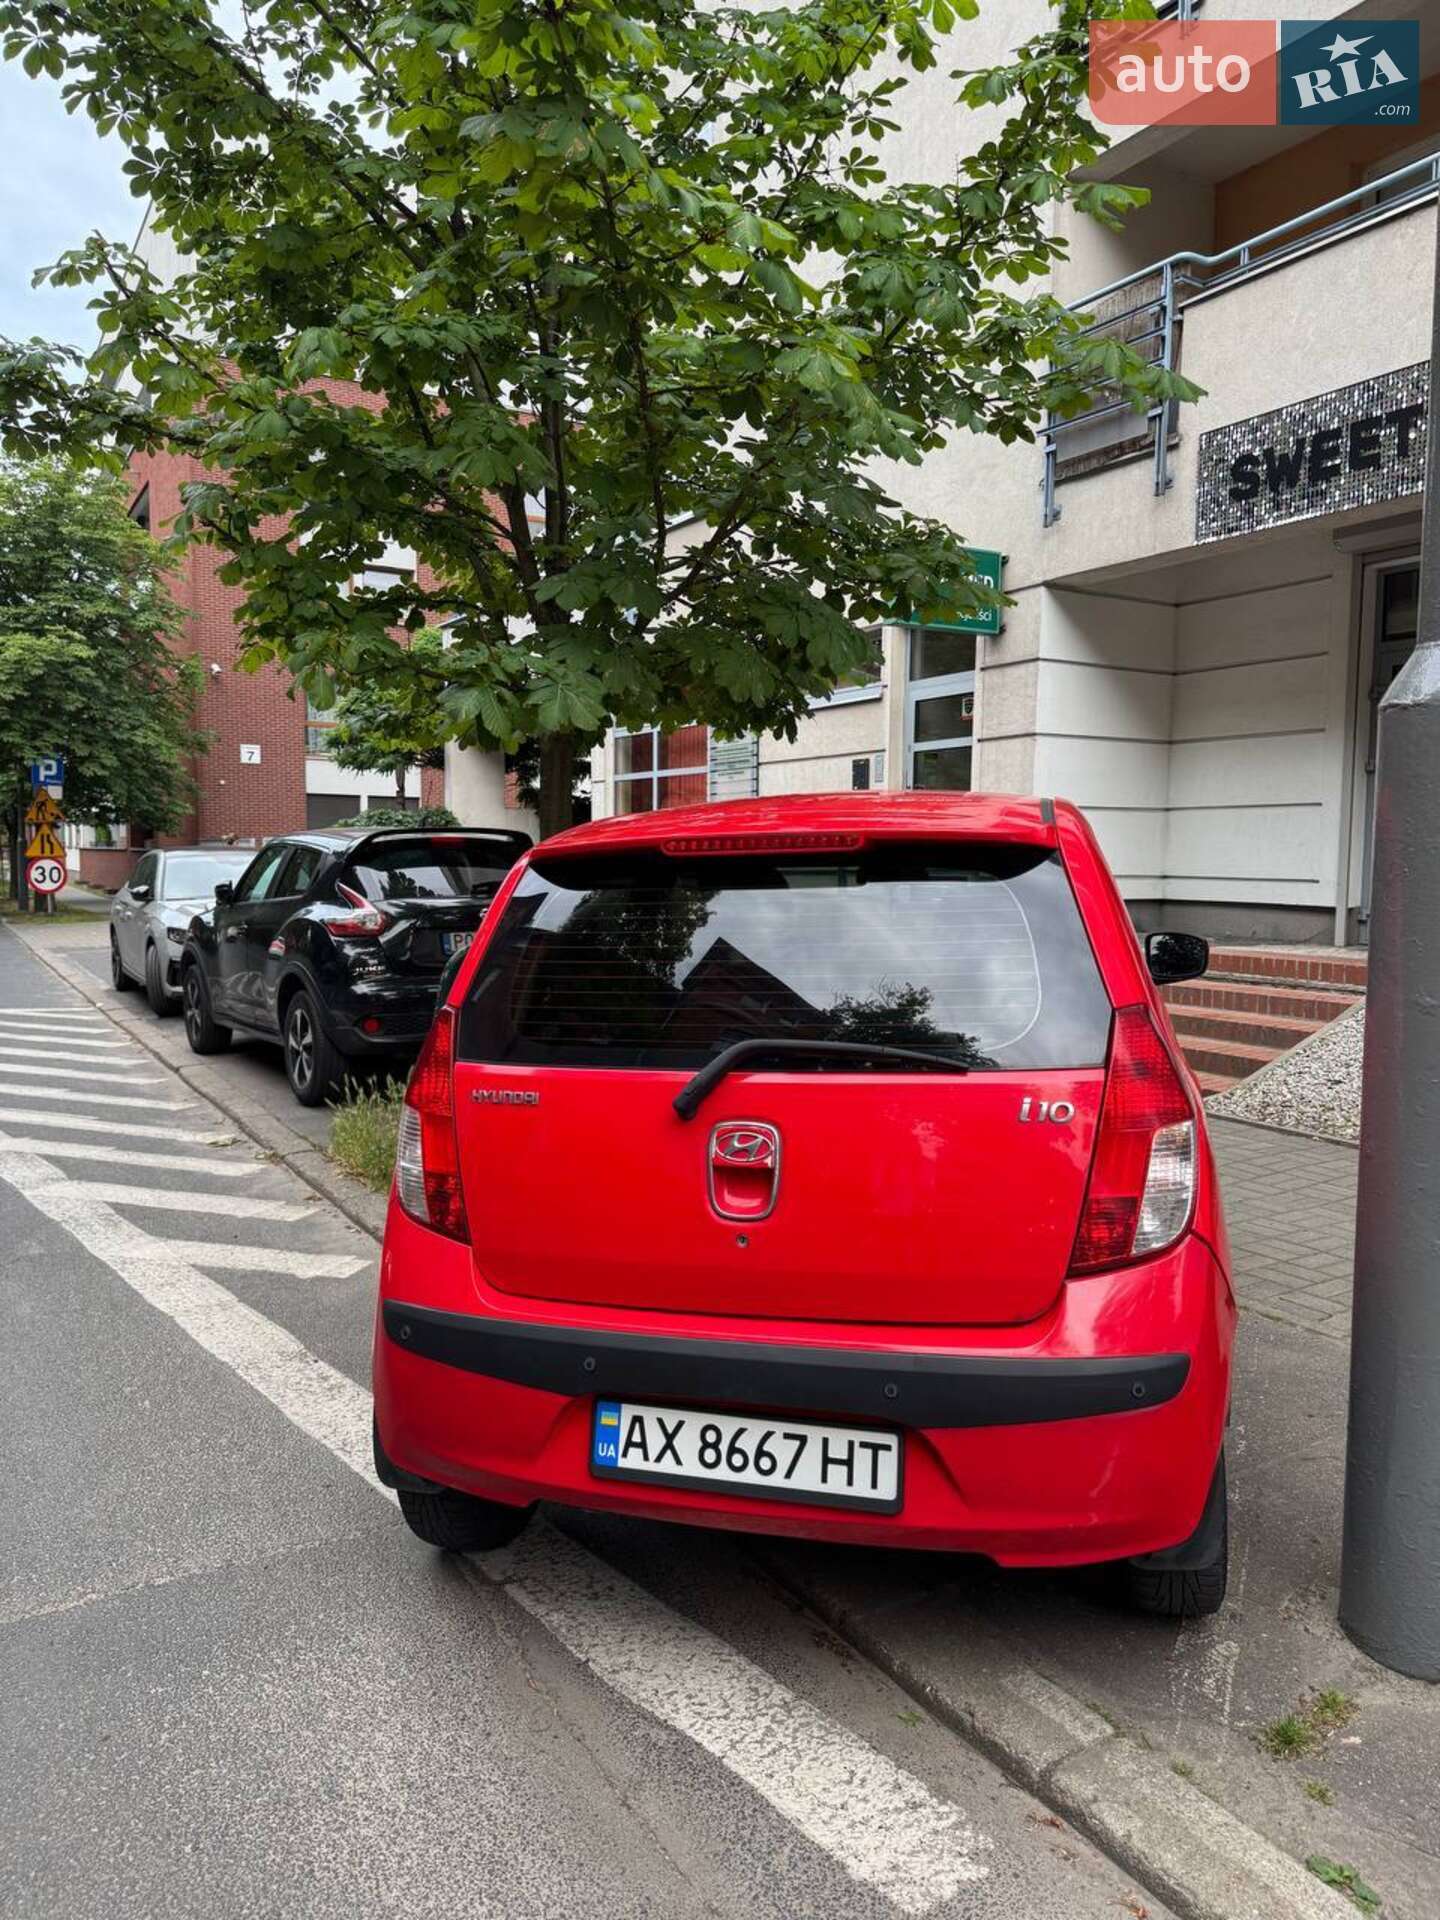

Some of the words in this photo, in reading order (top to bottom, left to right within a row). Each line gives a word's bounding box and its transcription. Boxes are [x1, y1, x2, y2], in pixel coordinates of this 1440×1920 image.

[1229, 402, 1424, 501] SWEET
[246, 750, 256, 761] 7
[39, 759, 58, 782] P
[34, 866, 62, 884] 30
[471, 1089, 540, 1105] HYUNDAI
[1019, 1097, 1075, 1123] i10
[598, 1442, 616, 1459] UA
[621, 1414, 687, 1467] AX
[698, 1423, 808, 1480] 8667
[820, 1436, 893, 1490] HT
